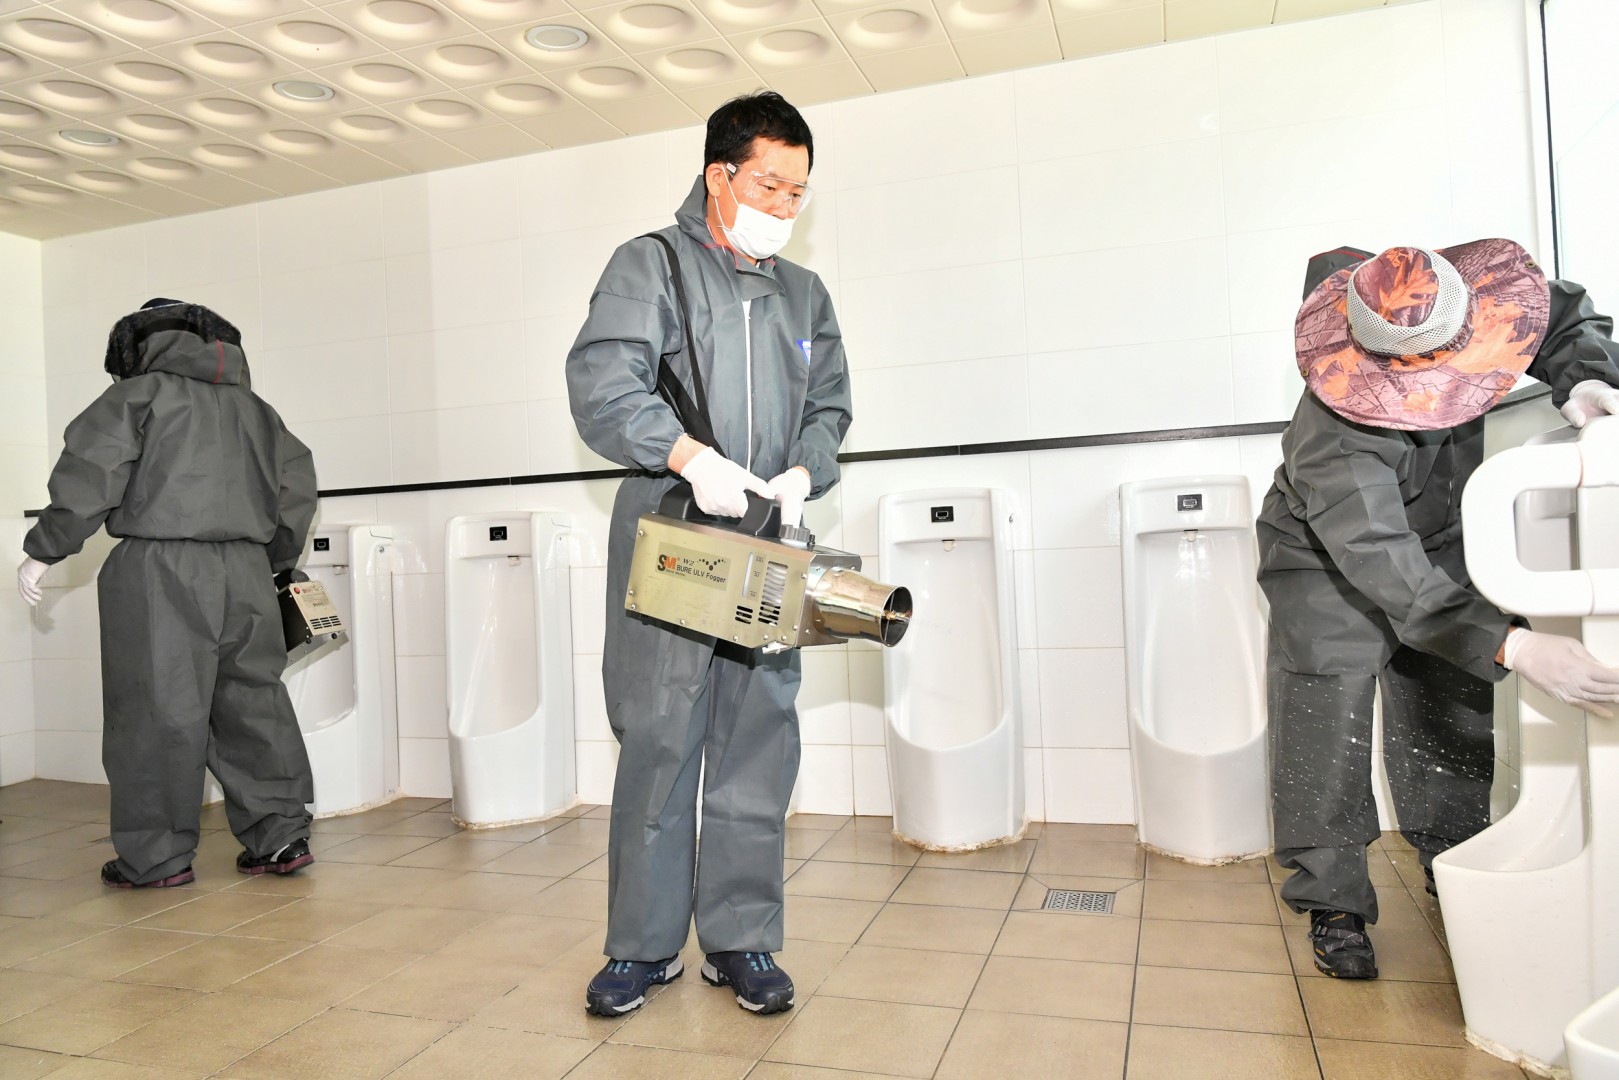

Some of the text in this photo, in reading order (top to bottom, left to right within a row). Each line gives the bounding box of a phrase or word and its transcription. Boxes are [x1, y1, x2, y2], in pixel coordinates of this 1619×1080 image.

[677, 565, 692, 574] BURE
[693, 569, 705, 577] ULV
[706, 572, 727, 583] Fogger
